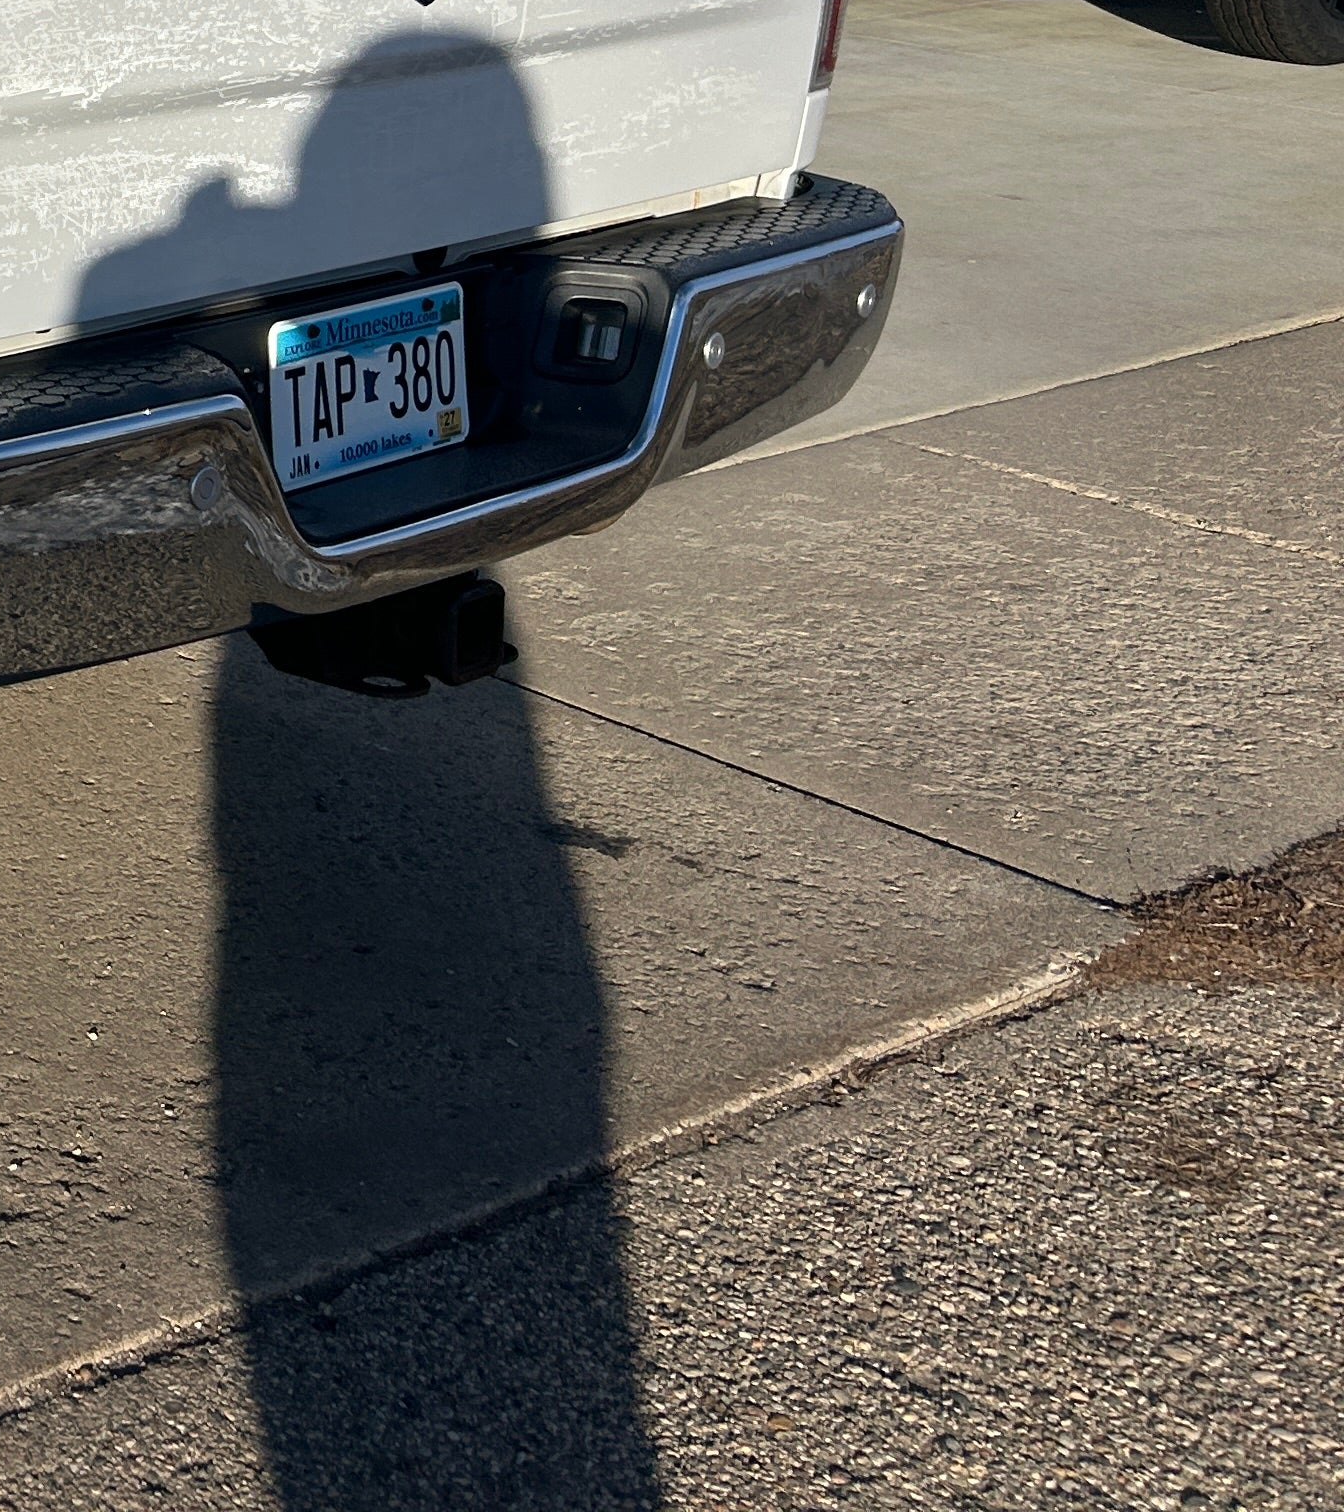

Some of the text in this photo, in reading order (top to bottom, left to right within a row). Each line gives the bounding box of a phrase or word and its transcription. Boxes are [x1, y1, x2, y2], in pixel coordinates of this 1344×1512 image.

[284, 330, 456, 448] TAP 380
[339, 432, 412, 463] 10,000 lakes
[289, 453, 311, 480] JAN
